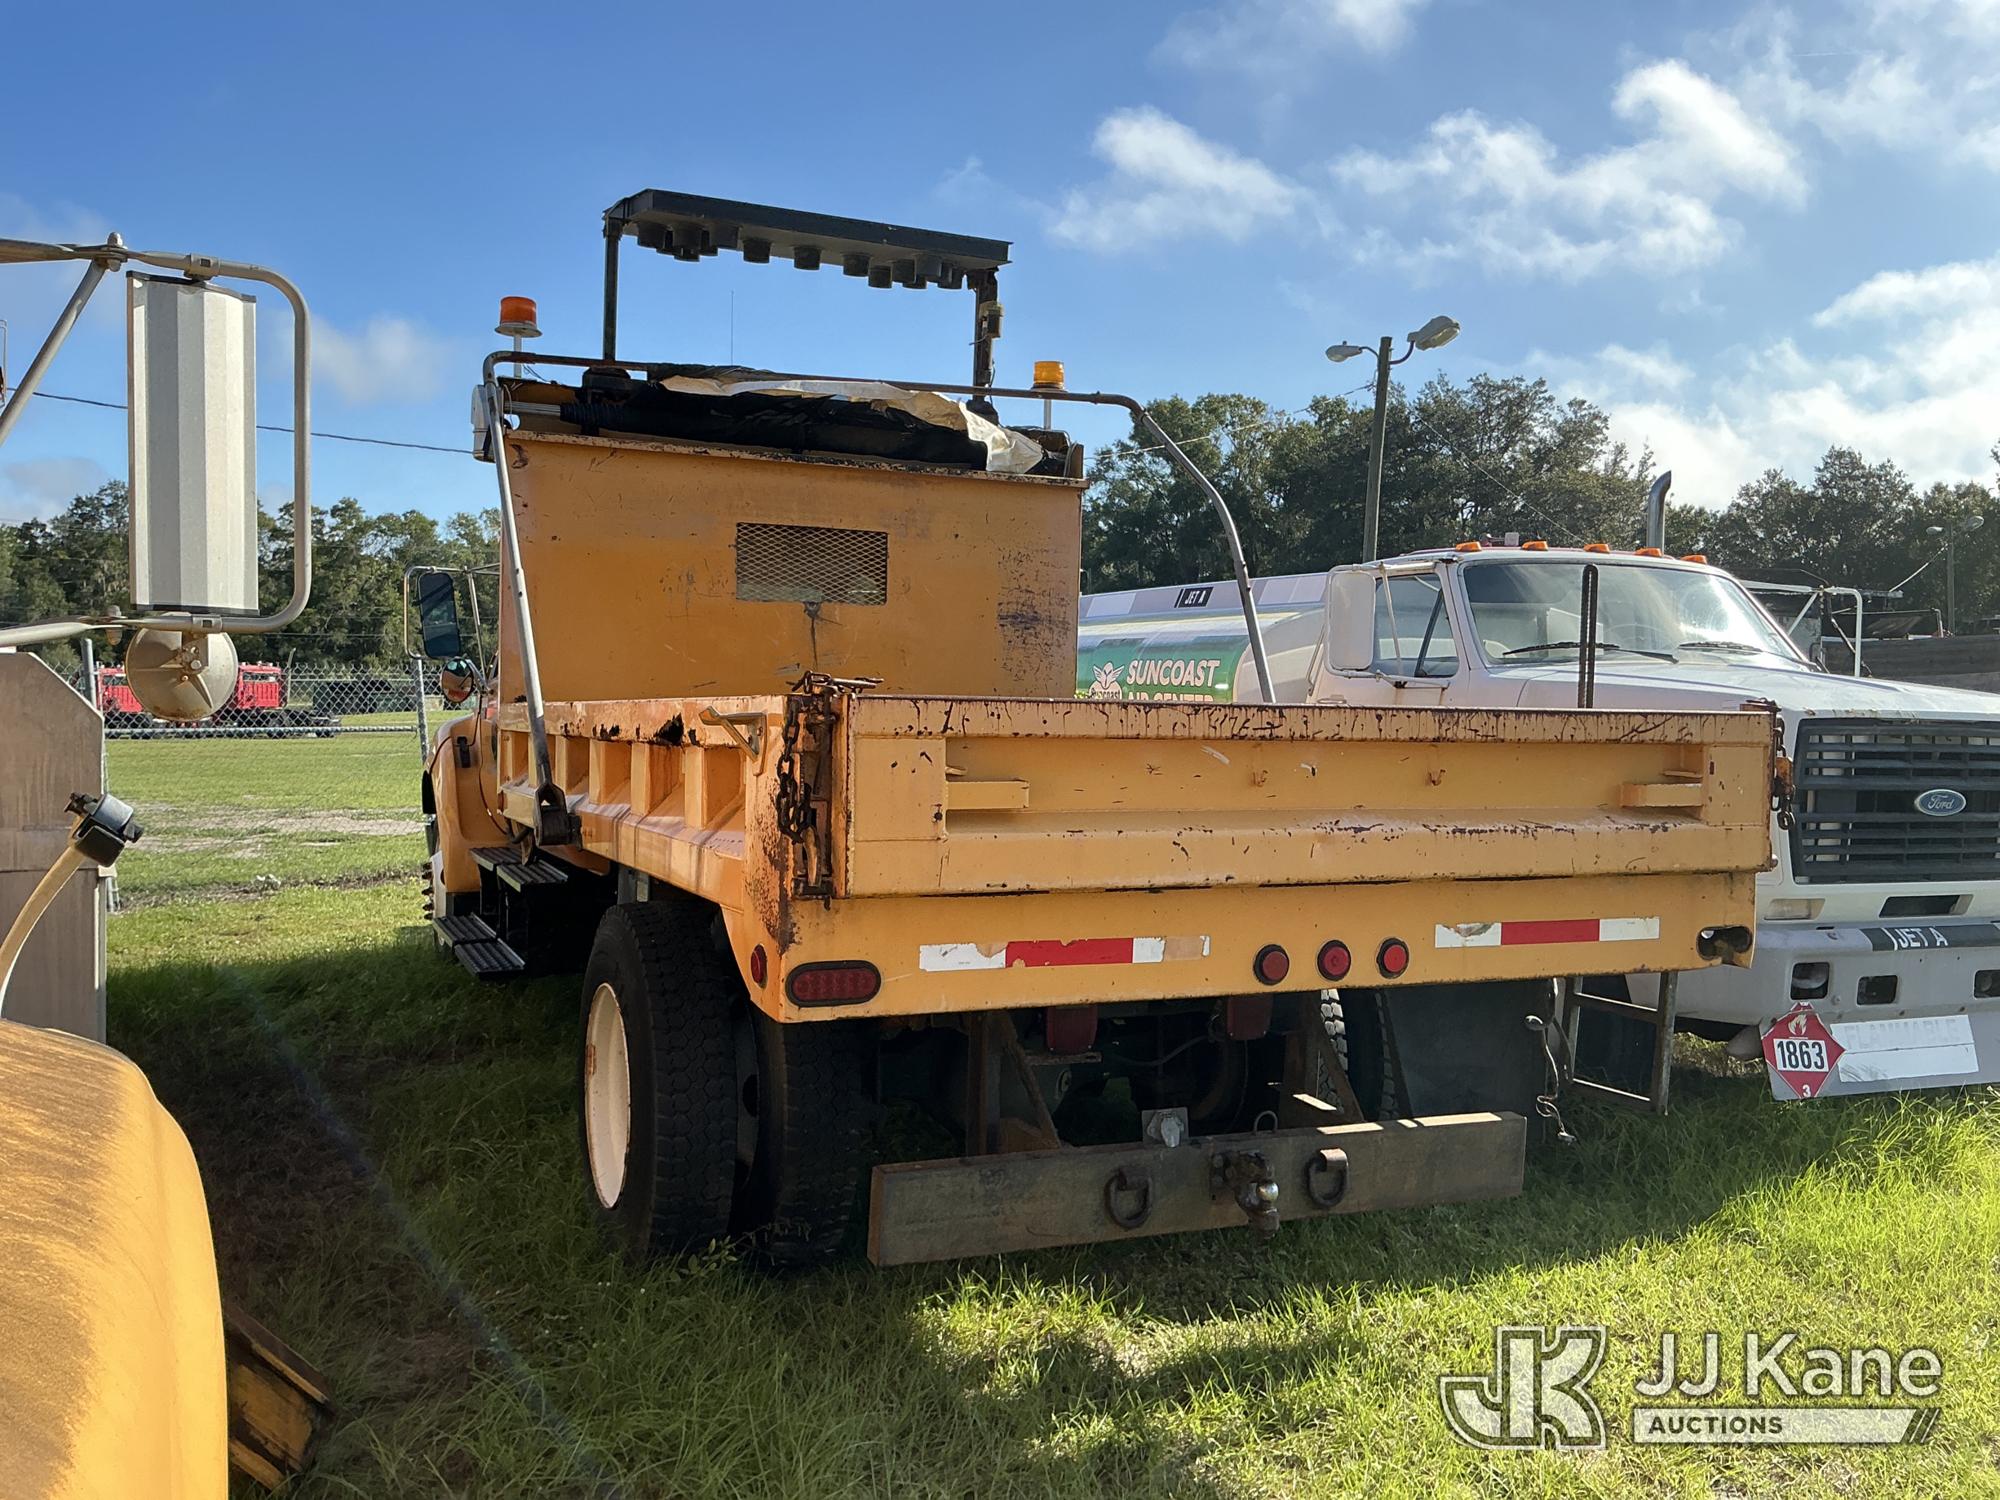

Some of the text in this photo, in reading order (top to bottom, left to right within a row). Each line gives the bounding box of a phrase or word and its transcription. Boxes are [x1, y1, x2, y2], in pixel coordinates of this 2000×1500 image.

[1184, 590, 1206, 604] JET A
[1127, 660, 1220, 687] SUNCOAST
[1927, 794, 1955, 810] Ford
[1896, 927, 1949, 948] JET A
[1777, 1040, 1825, 1070] 1863
[1802, 1084, 1812, 1098] 3
